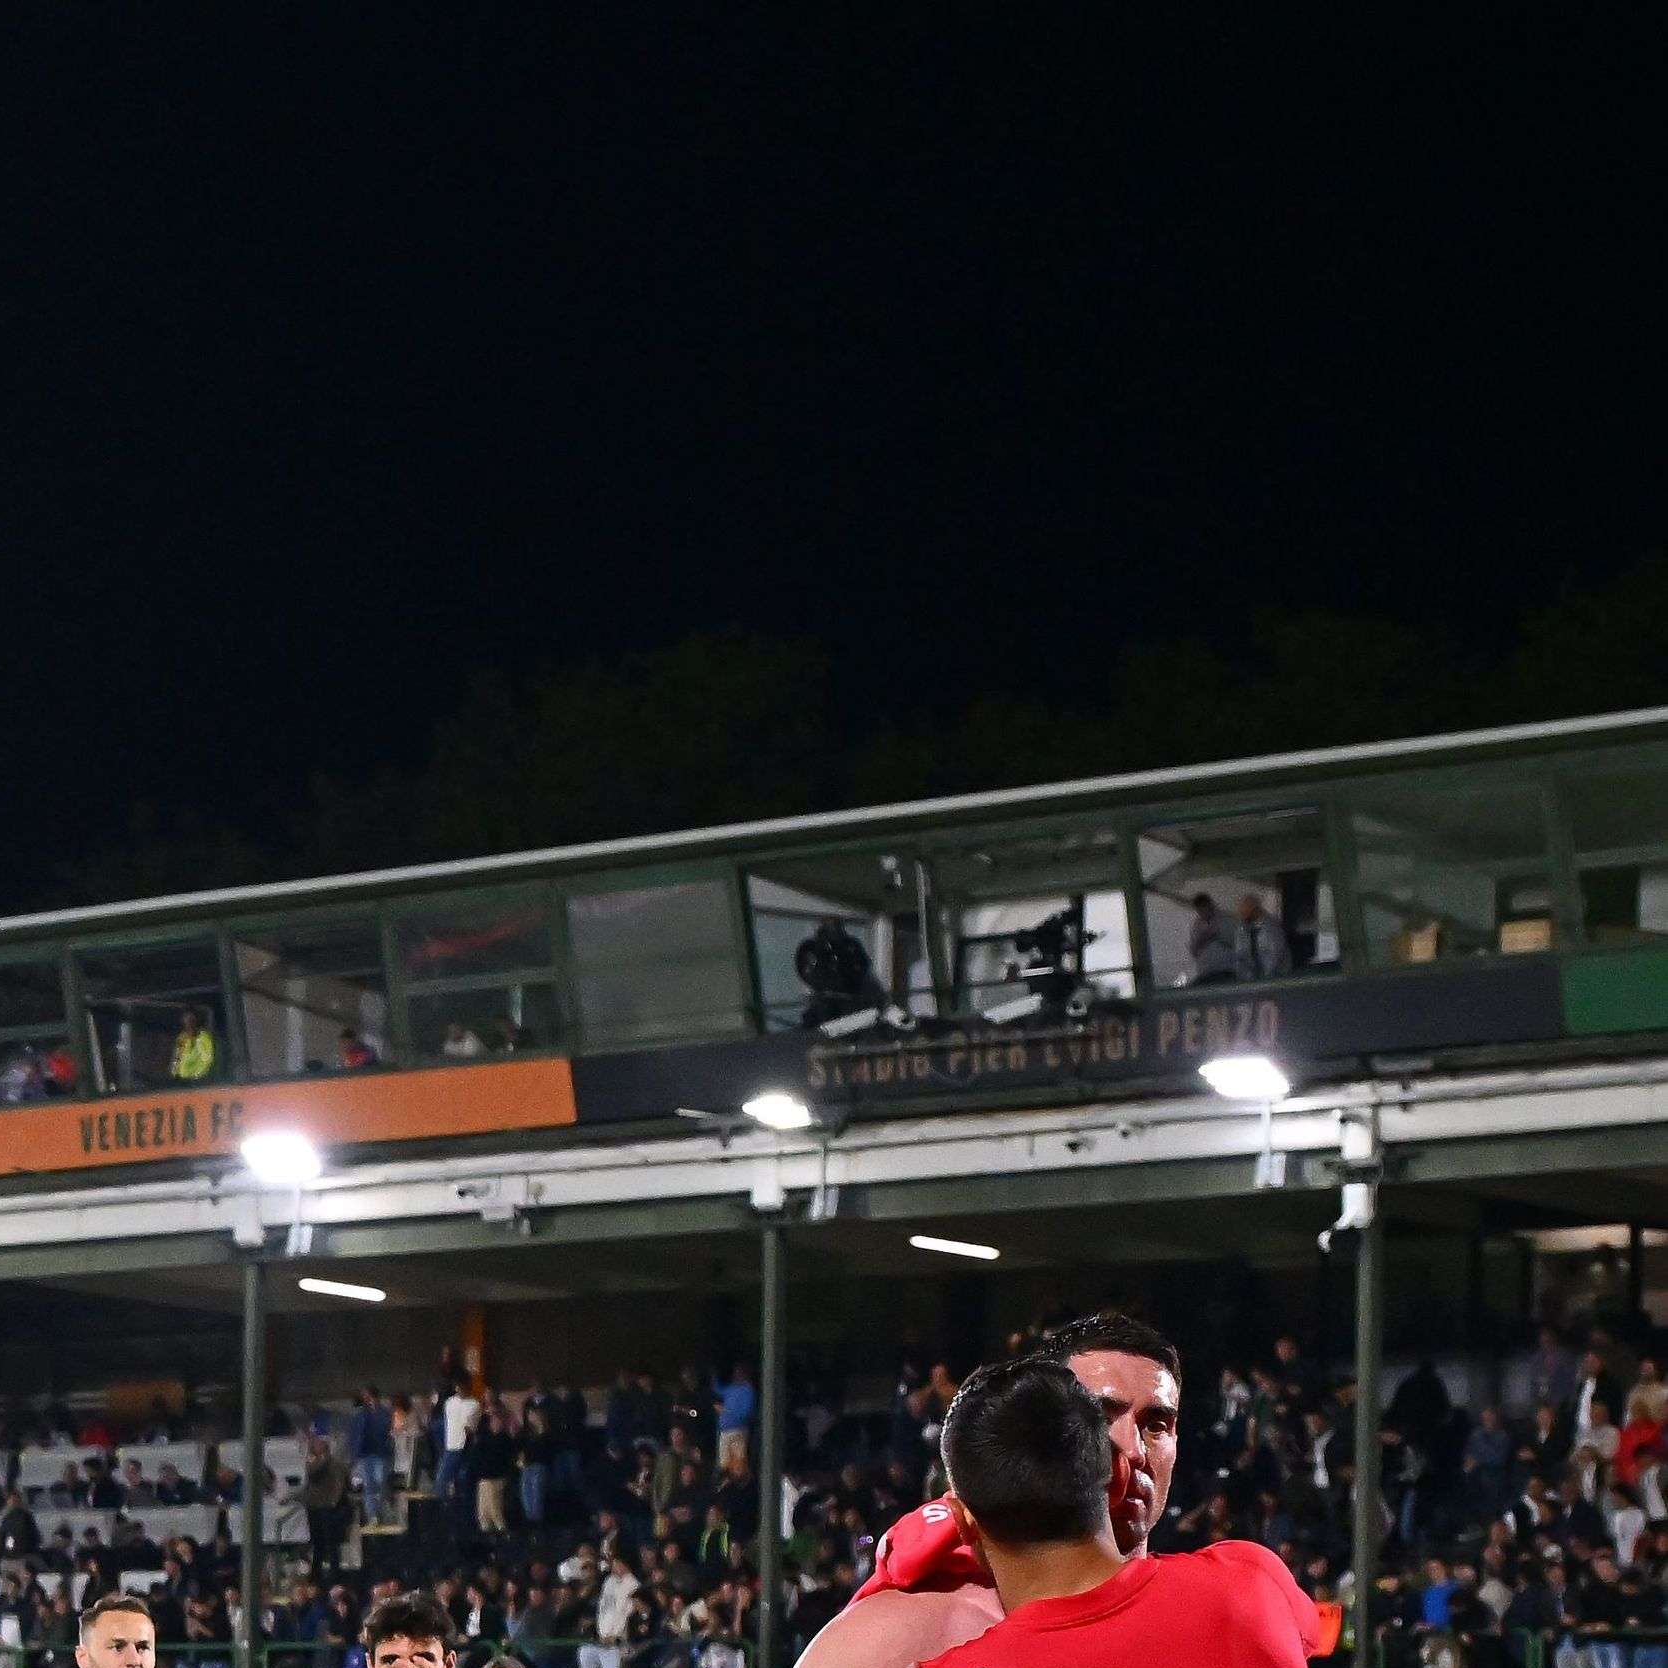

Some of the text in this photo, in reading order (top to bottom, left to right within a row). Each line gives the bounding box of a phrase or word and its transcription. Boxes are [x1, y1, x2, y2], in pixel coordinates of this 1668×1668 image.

[1163, 1001, 1279, 1056] PENZO
[80, 1101, 244, 1153] VENEZIA FC
